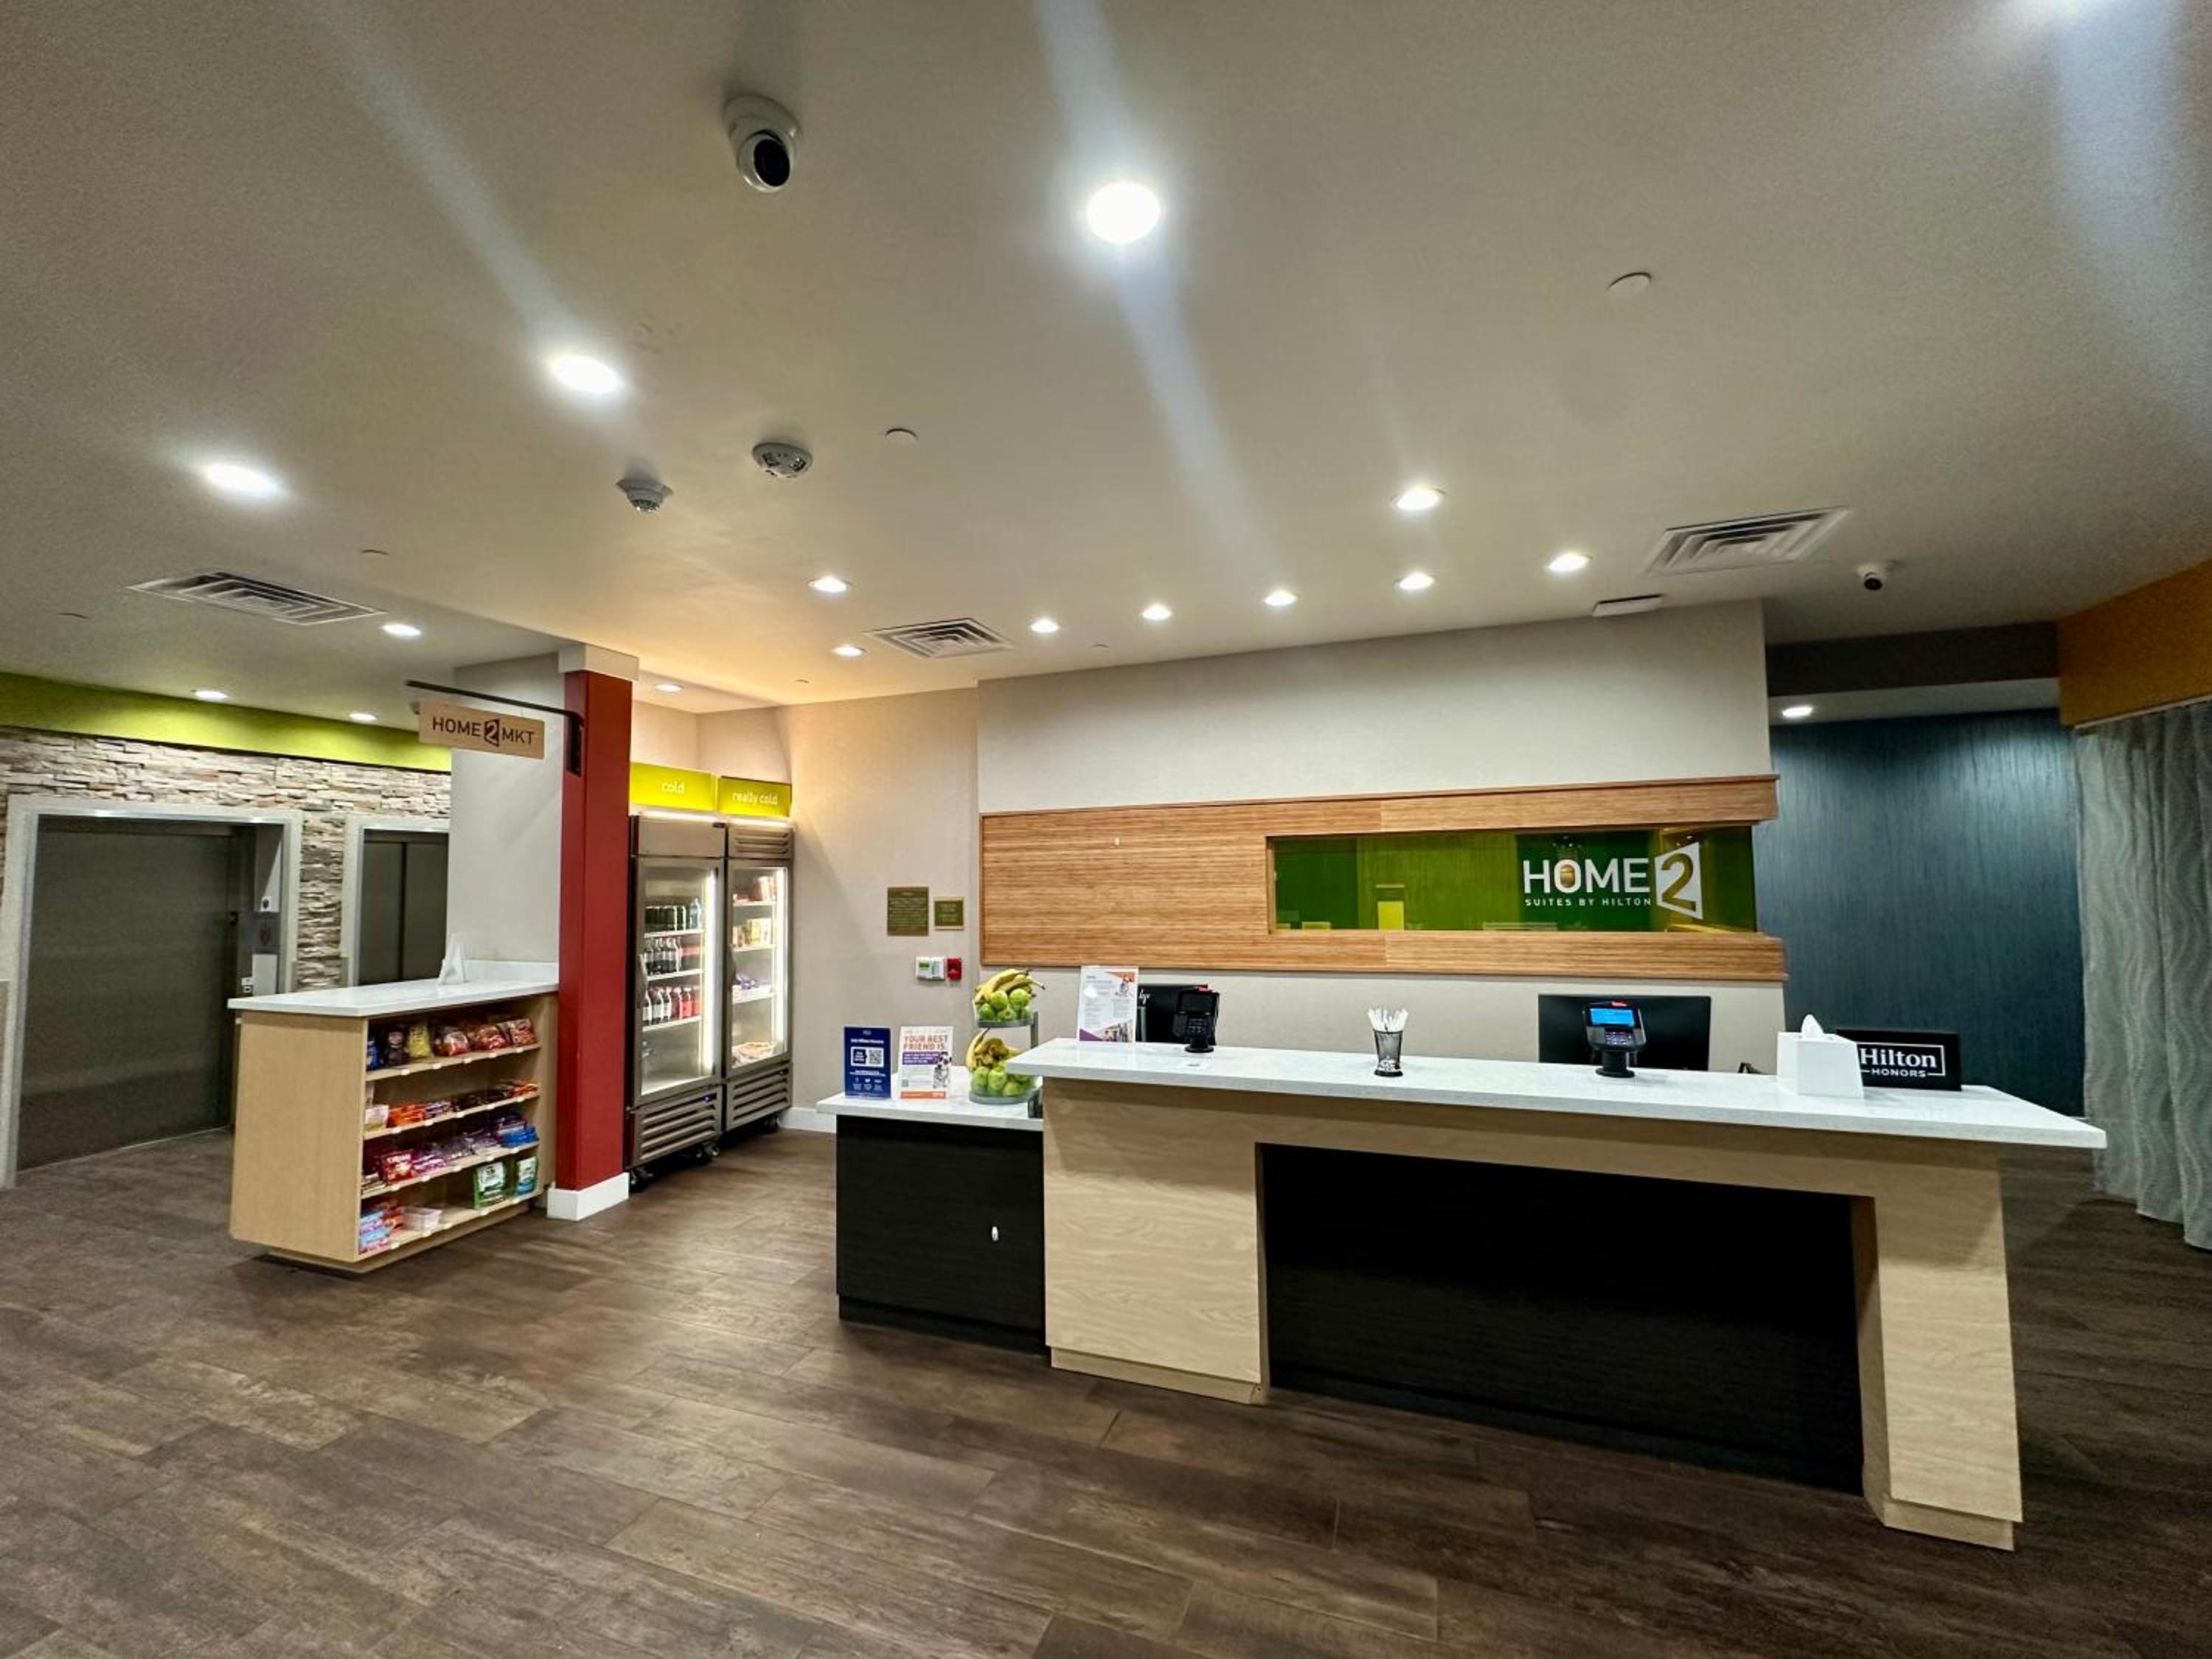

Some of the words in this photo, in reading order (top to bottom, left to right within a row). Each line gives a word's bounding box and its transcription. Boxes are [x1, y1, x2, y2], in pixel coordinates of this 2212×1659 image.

[661, 780, 685, 794] cold
[732, 790, 758, 806] really
[759, 792, 778, 805] cold
[1524, 898, 1572, 906] SUITES
[1579, 898, 1594, 906] BY
[1602, 897, 1651, 906] HILTON
[1860, 1048, 1937, 1068] Hilton
[1871, 1068, 1927, 1077] HONORS
